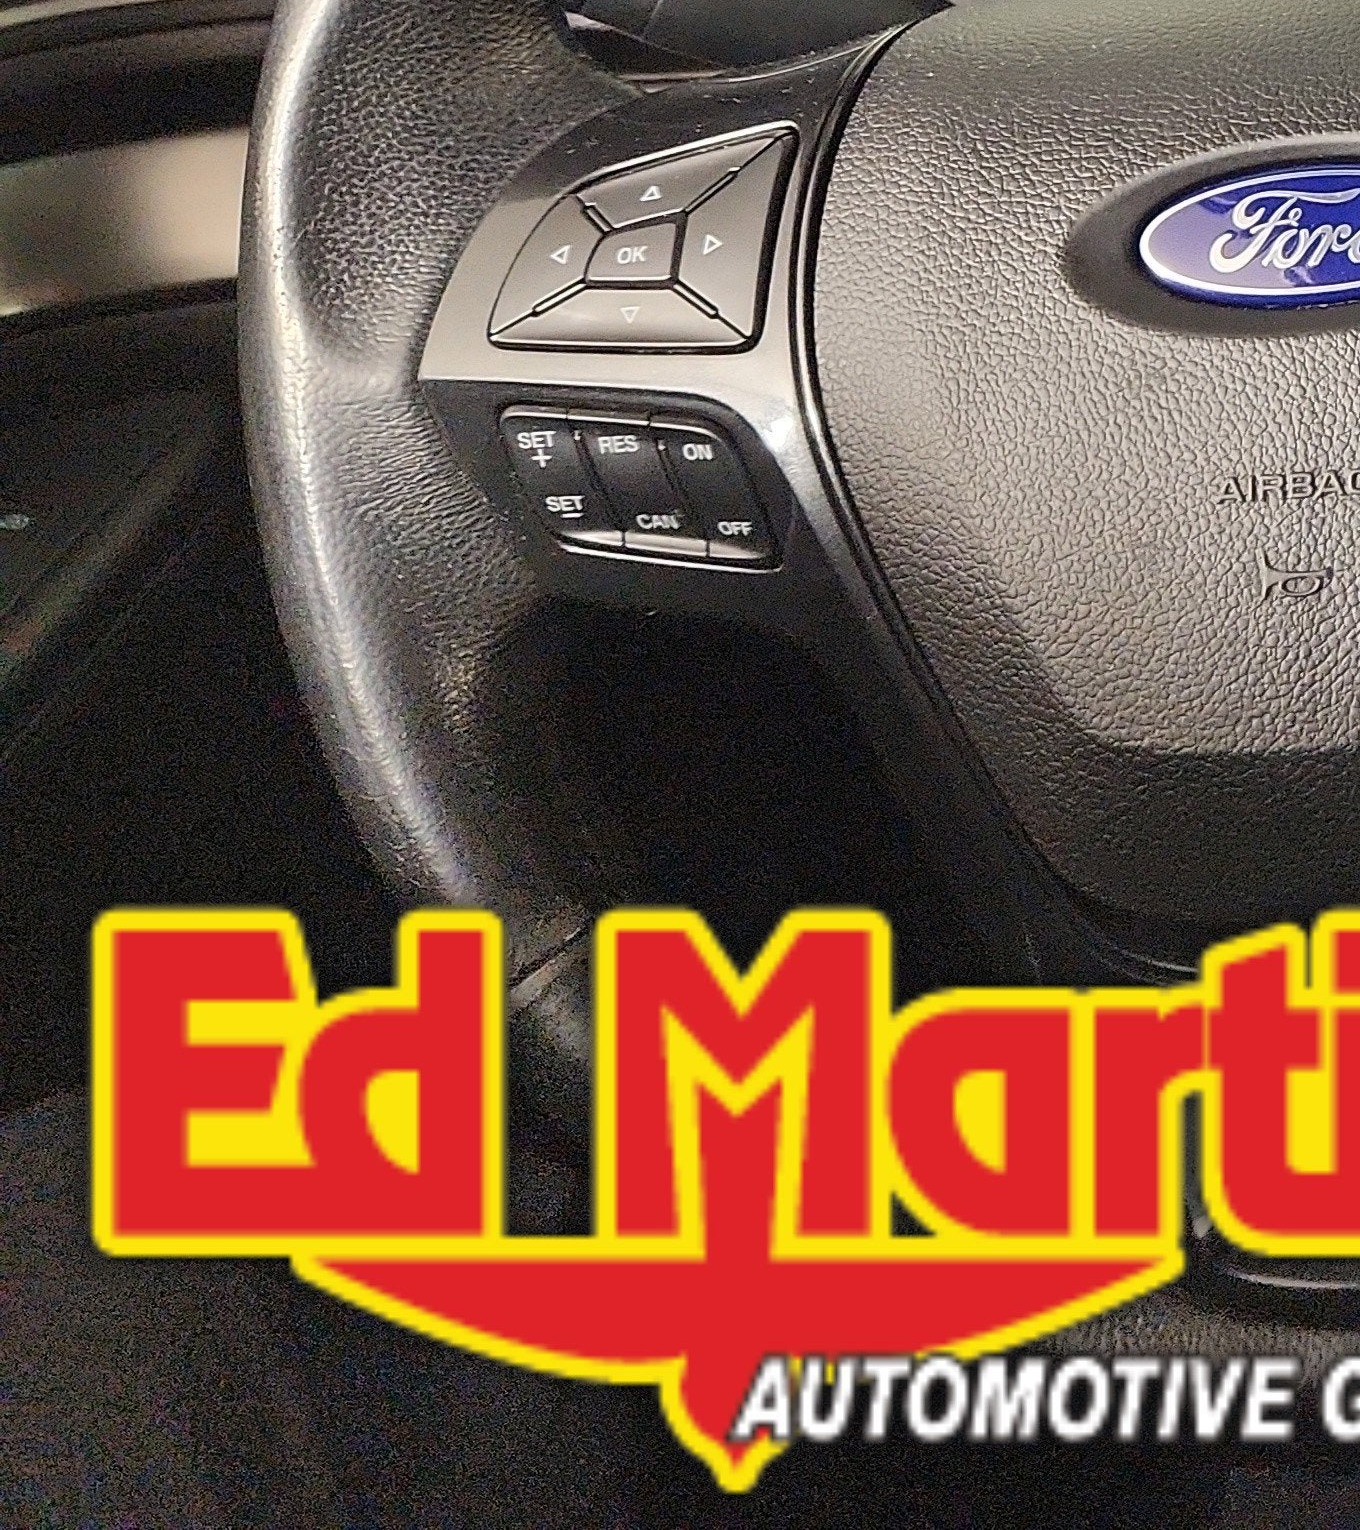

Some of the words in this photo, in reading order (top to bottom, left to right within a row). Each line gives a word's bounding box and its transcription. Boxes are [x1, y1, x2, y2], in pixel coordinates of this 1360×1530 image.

[616, 246, 648, 265] OK
[517, 430, 556, 449] SET
[598, 435, 640, 454] RES
[682, 443, 713, 460] ON
[545, 495, 585, 512] SET
[636, 514, 680, 530] CAN
[717, 521, 753, 536] OFF
